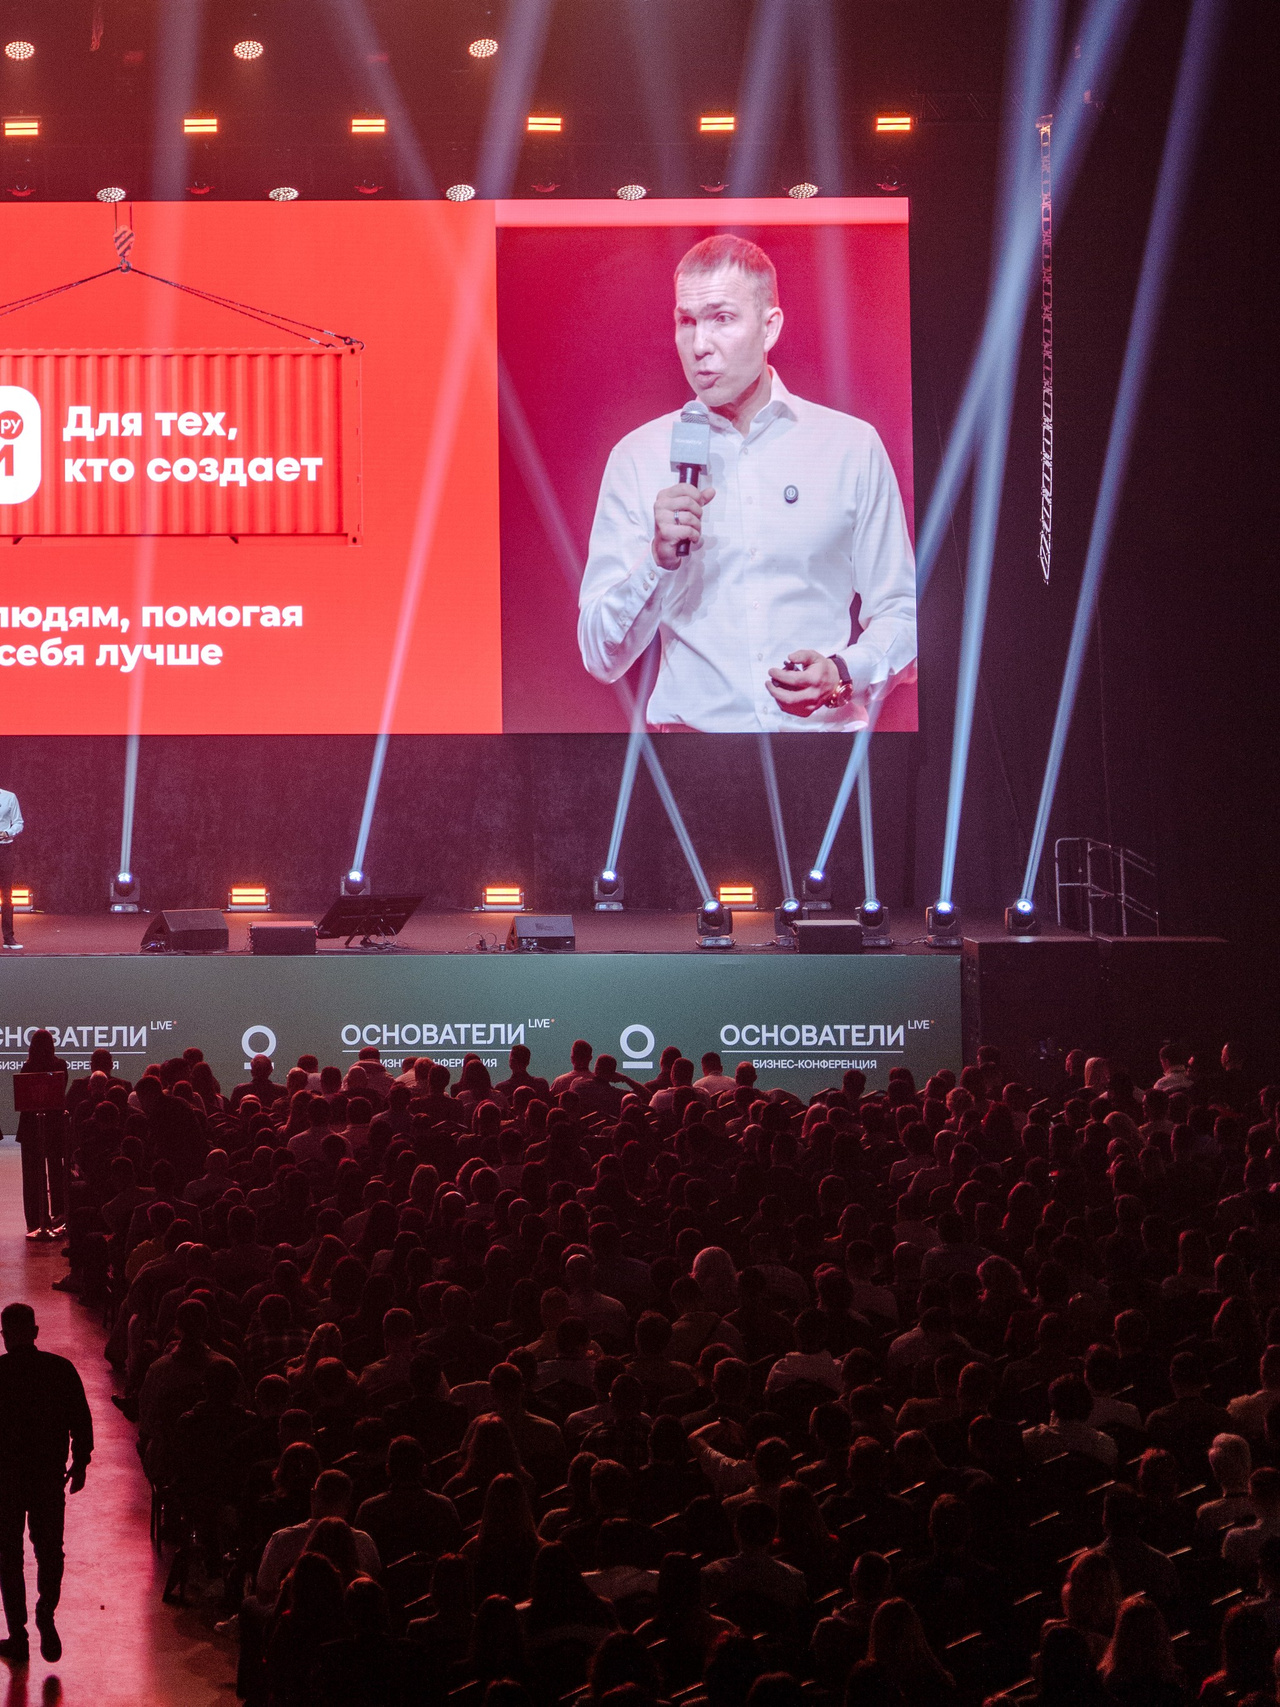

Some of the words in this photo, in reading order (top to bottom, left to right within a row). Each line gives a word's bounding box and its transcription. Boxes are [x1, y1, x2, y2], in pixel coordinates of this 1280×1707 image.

[62, 405, 143, 442] Для
[154, 410, 238, 441] тех,
[64, 457, 135, 483] кто
[146, 456, 324, 488] создает
[141, 605, 303, 628] помогая
[95, 643, 224, 673] лучше
[150, 1020, 173, 1031] LIVE
[340, 1023, 525, 1046] ОСНОВАТЕЛИ
[528, 1018, 551, 1029] LIVE
[719, 1024, 904, 1047] ОСНОВАТЕЛИ
[907, 1019, 930, 1030] LIVE
[752, 1059, 877, 1071] БИЗНЕС-КОНФЕРЕНЦИЯ
